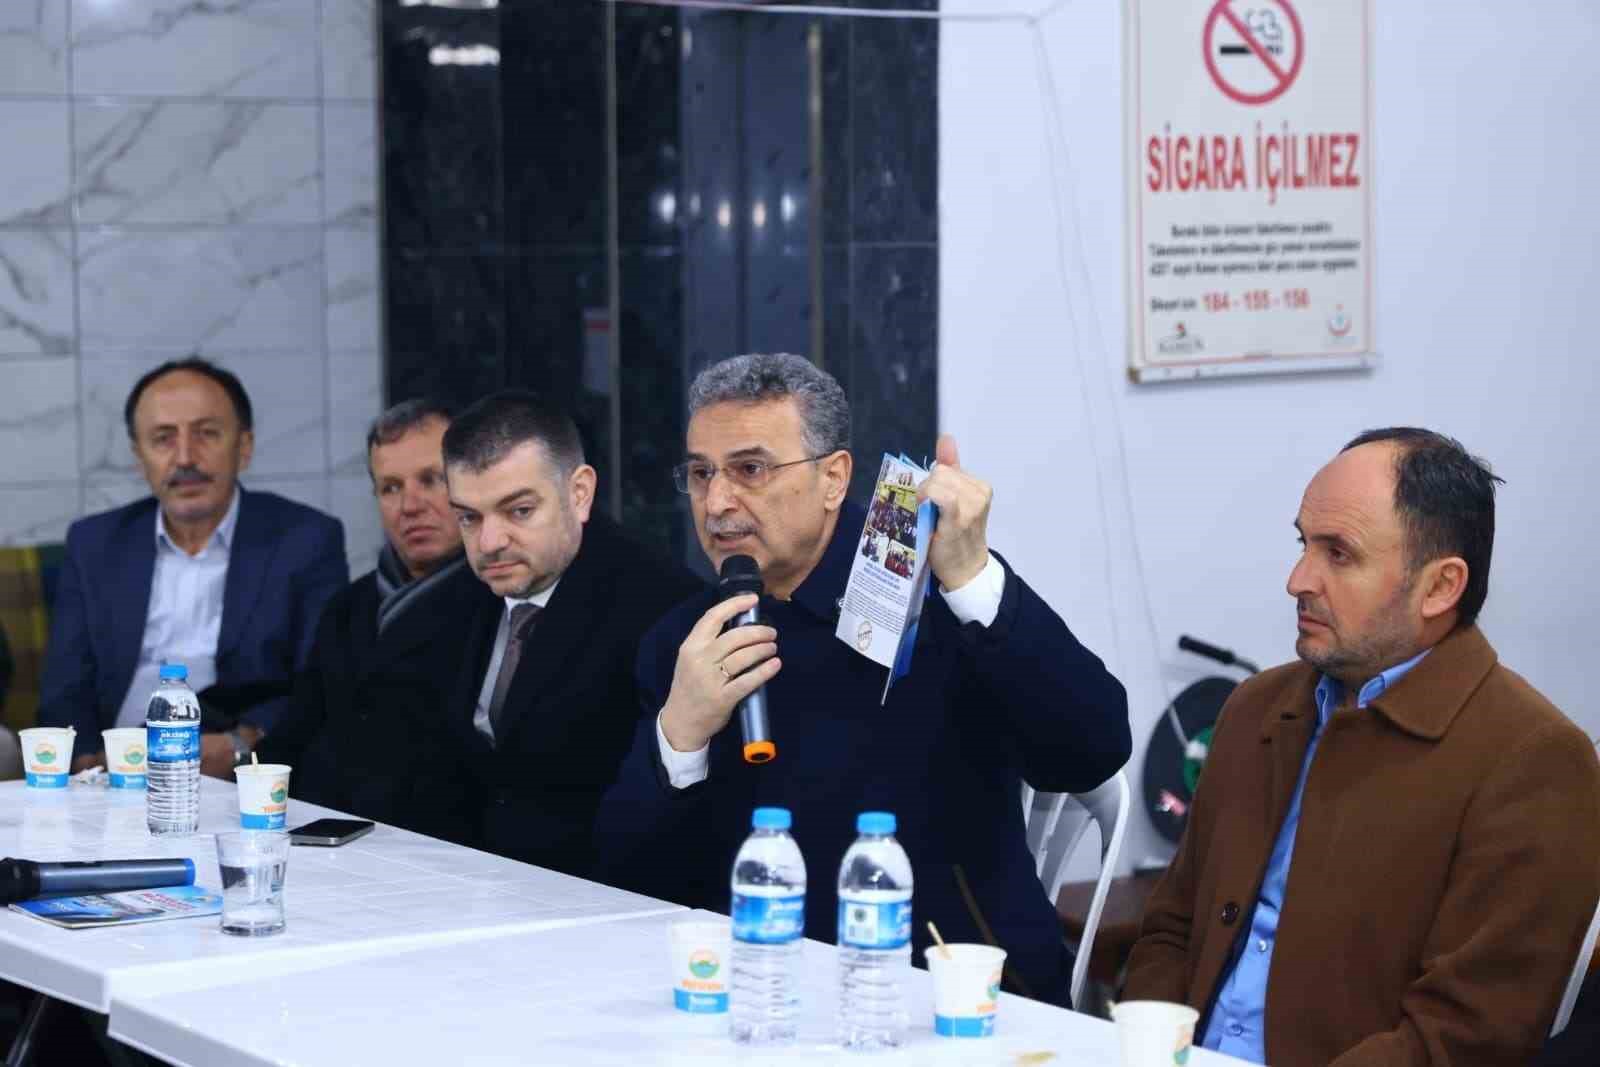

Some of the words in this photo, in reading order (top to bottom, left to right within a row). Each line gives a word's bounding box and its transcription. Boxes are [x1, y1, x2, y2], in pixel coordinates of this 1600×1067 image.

[1148, 122, 1246, 191] SİGARA
[1256, 121, 1360, 205] İÇİLMEZ
[1203, 292, 1230, 311] 184
